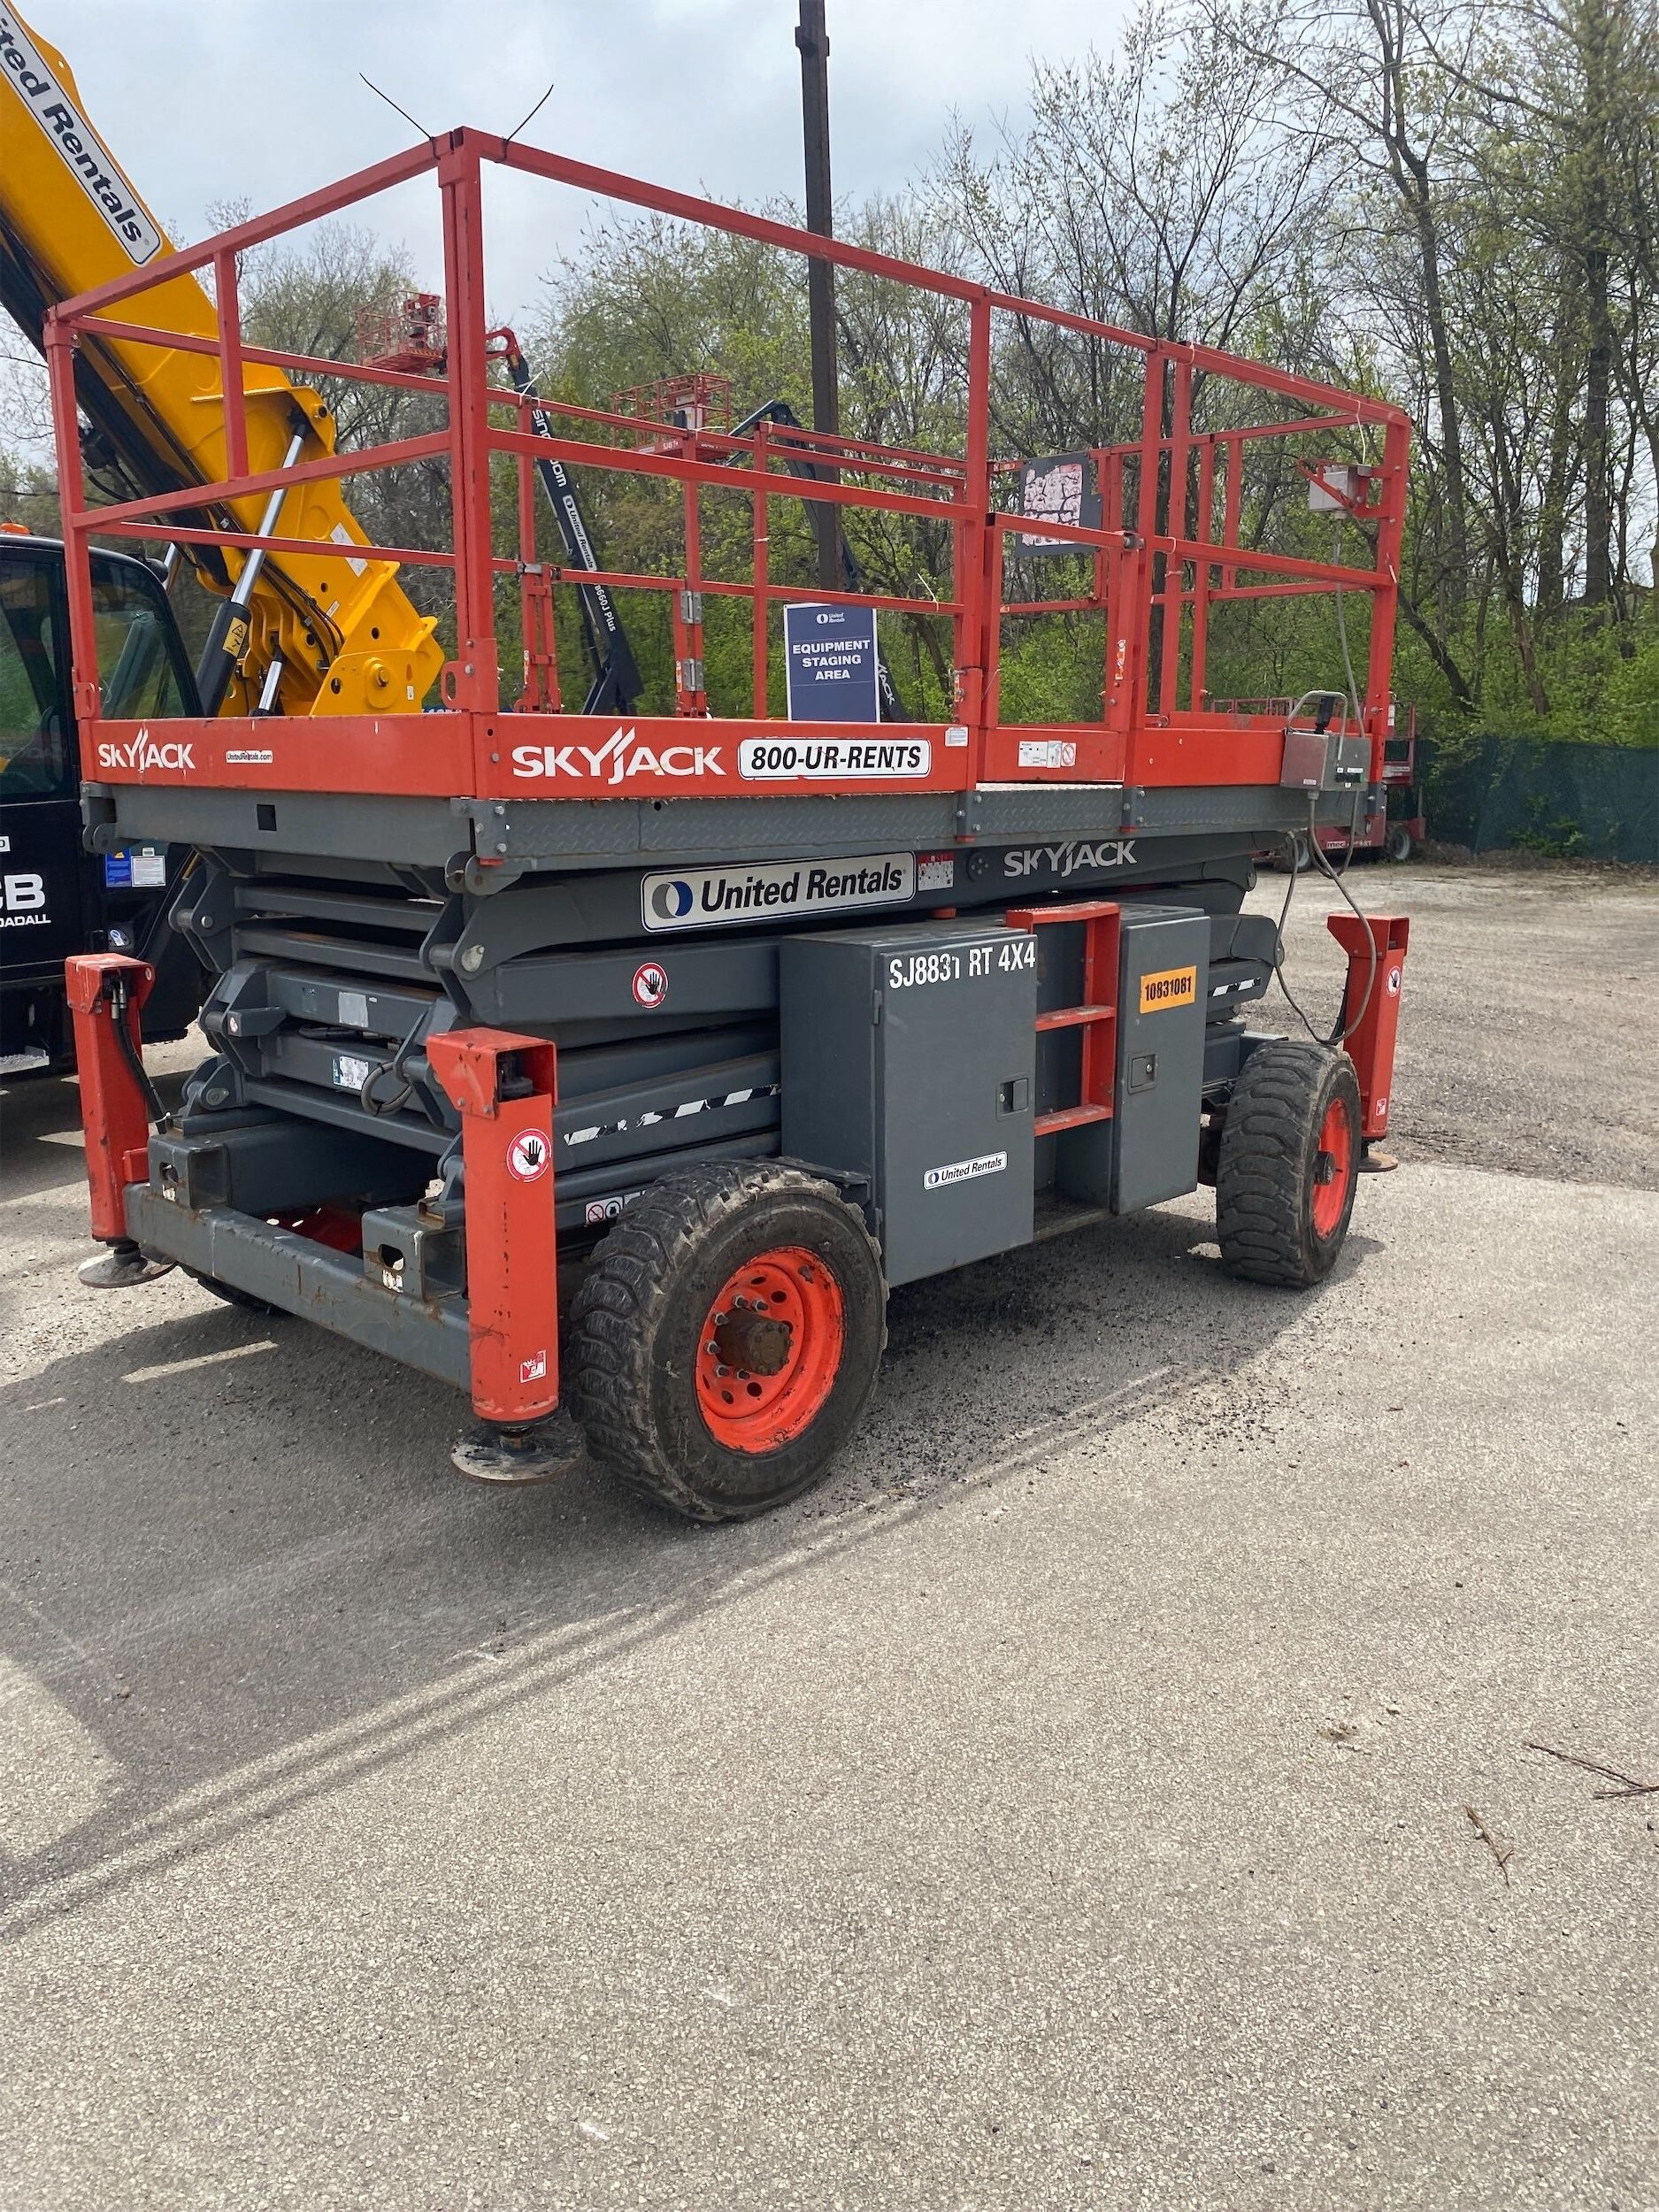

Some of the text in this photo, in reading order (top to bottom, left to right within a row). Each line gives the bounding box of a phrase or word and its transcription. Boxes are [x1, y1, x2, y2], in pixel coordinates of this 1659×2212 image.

[42, 103, 142, 242] Rentals
[569, 511, 594, 569] United Rentals
[603, 609, 616, 632] Plus
[792, 640, 871, 655] EQUIPMENT
[802, 655, 862, 668] STAGING
[815, 669, 851, 681] AREA
[98, 728, 196, 773] SKYJACK
[511, 726, 727, 786] SKYJACK
[751, 745, 922, 770] 800-UR-RENTS
[1003, 841, 1138, 878] SKYJACK
[701, 872, 801, 912] United
[806, 863, 902, 900] Rentals
[889, 941, 1036, 989] SJ8831 RT 4X4
[1145, 976, 1192, 1002] 10831081
[941, 1157, 1002, 1181] United Rentals
